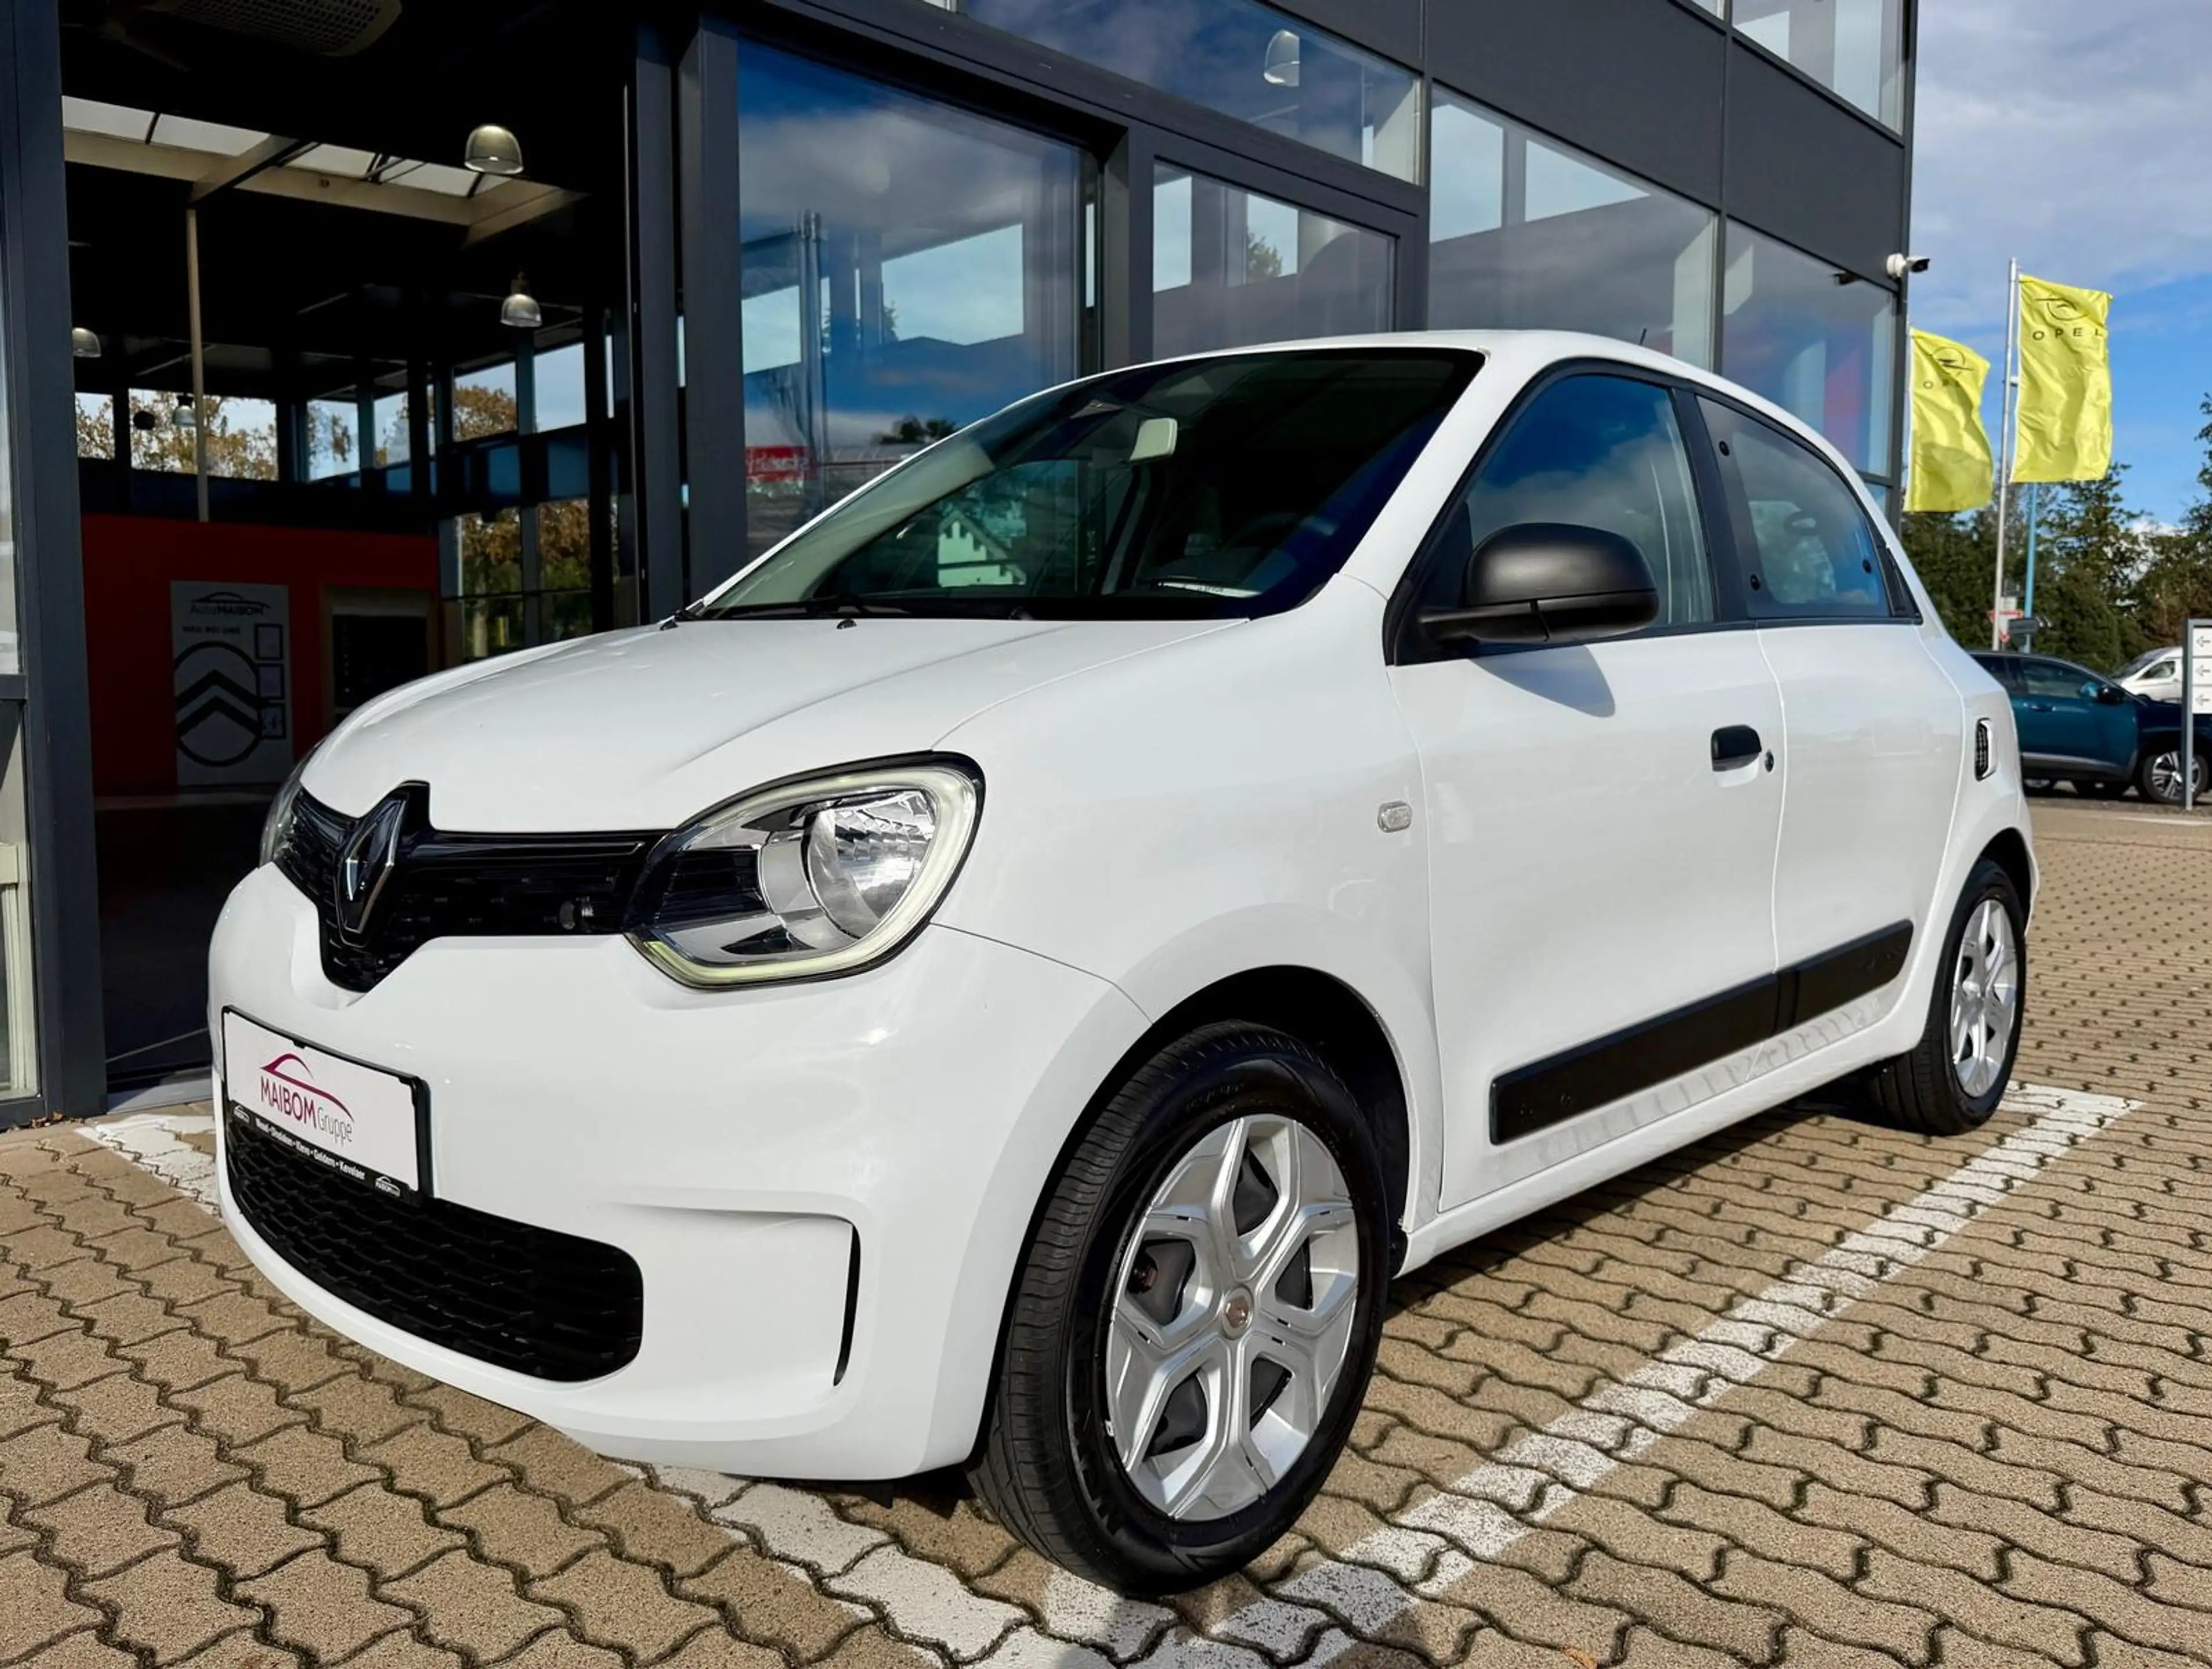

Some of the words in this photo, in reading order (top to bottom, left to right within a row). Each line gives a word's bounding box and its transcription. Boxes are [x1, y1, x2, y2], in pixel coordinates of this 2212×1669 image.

[2032, 327, 2104, 341] OPEL
[260, 1075, 318, 1129] MAIBOM
[318, 1106, 353, 1147] Gruppe
